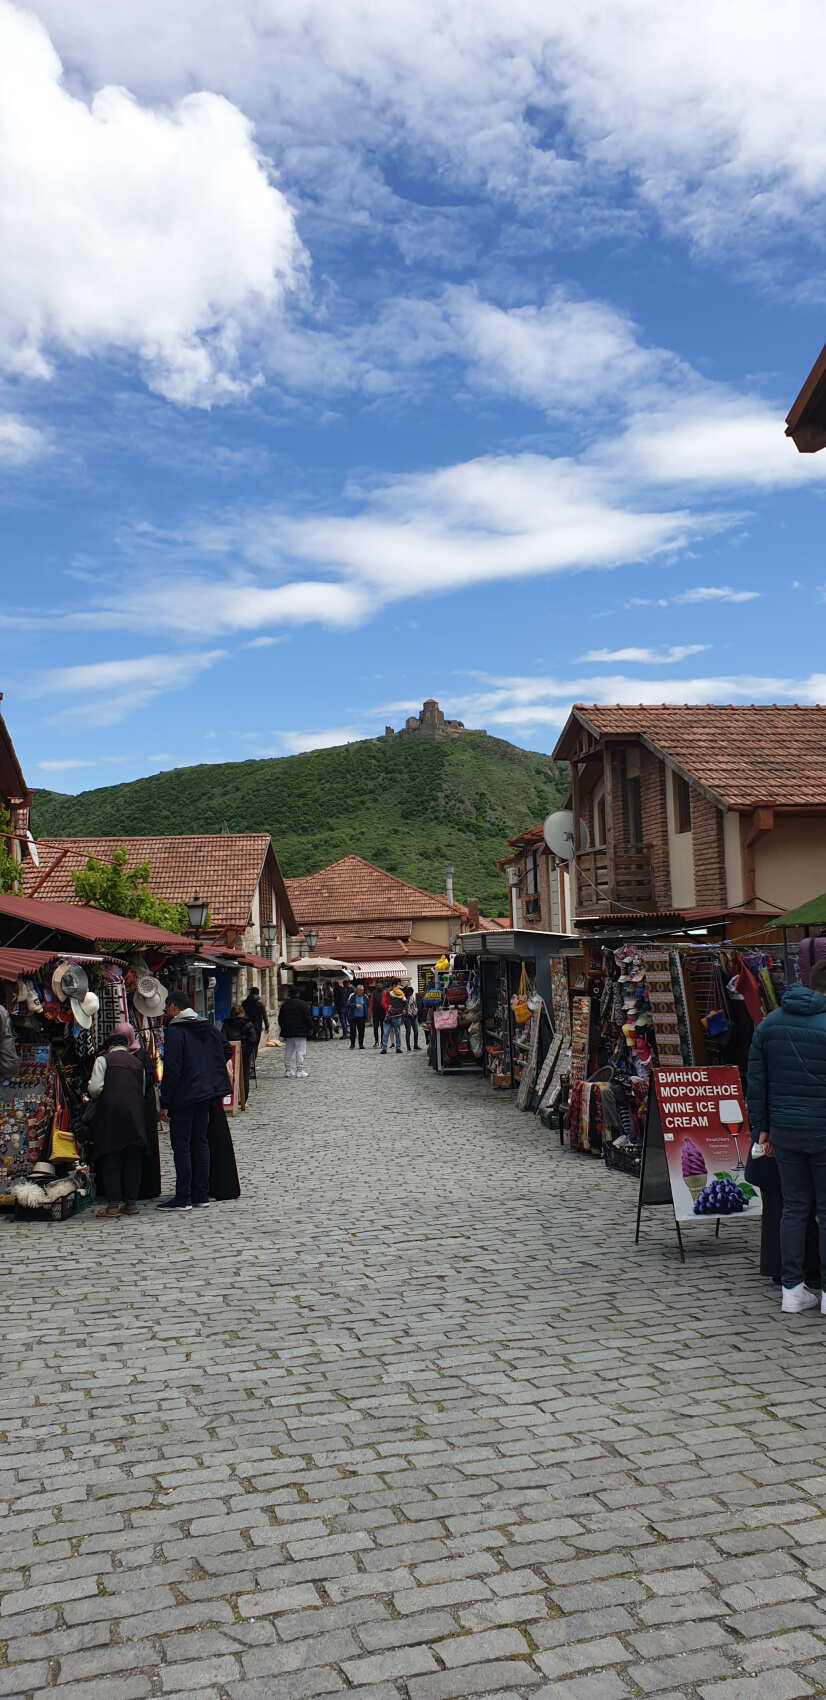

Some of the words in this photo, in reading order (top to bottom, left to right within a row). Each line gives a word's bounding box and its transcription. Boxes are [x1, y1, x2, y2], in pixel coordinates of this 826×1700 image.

[658, 1071, 708, 1083] ВИННОЕ
[660, 1085, 739, 1097] МОРОЖЕНОЕ
[662, 1102, 694, 1113] WINE
[696, 1101, 716, 1112] ICE
[665, 1116, 709, 1128] CREAM
